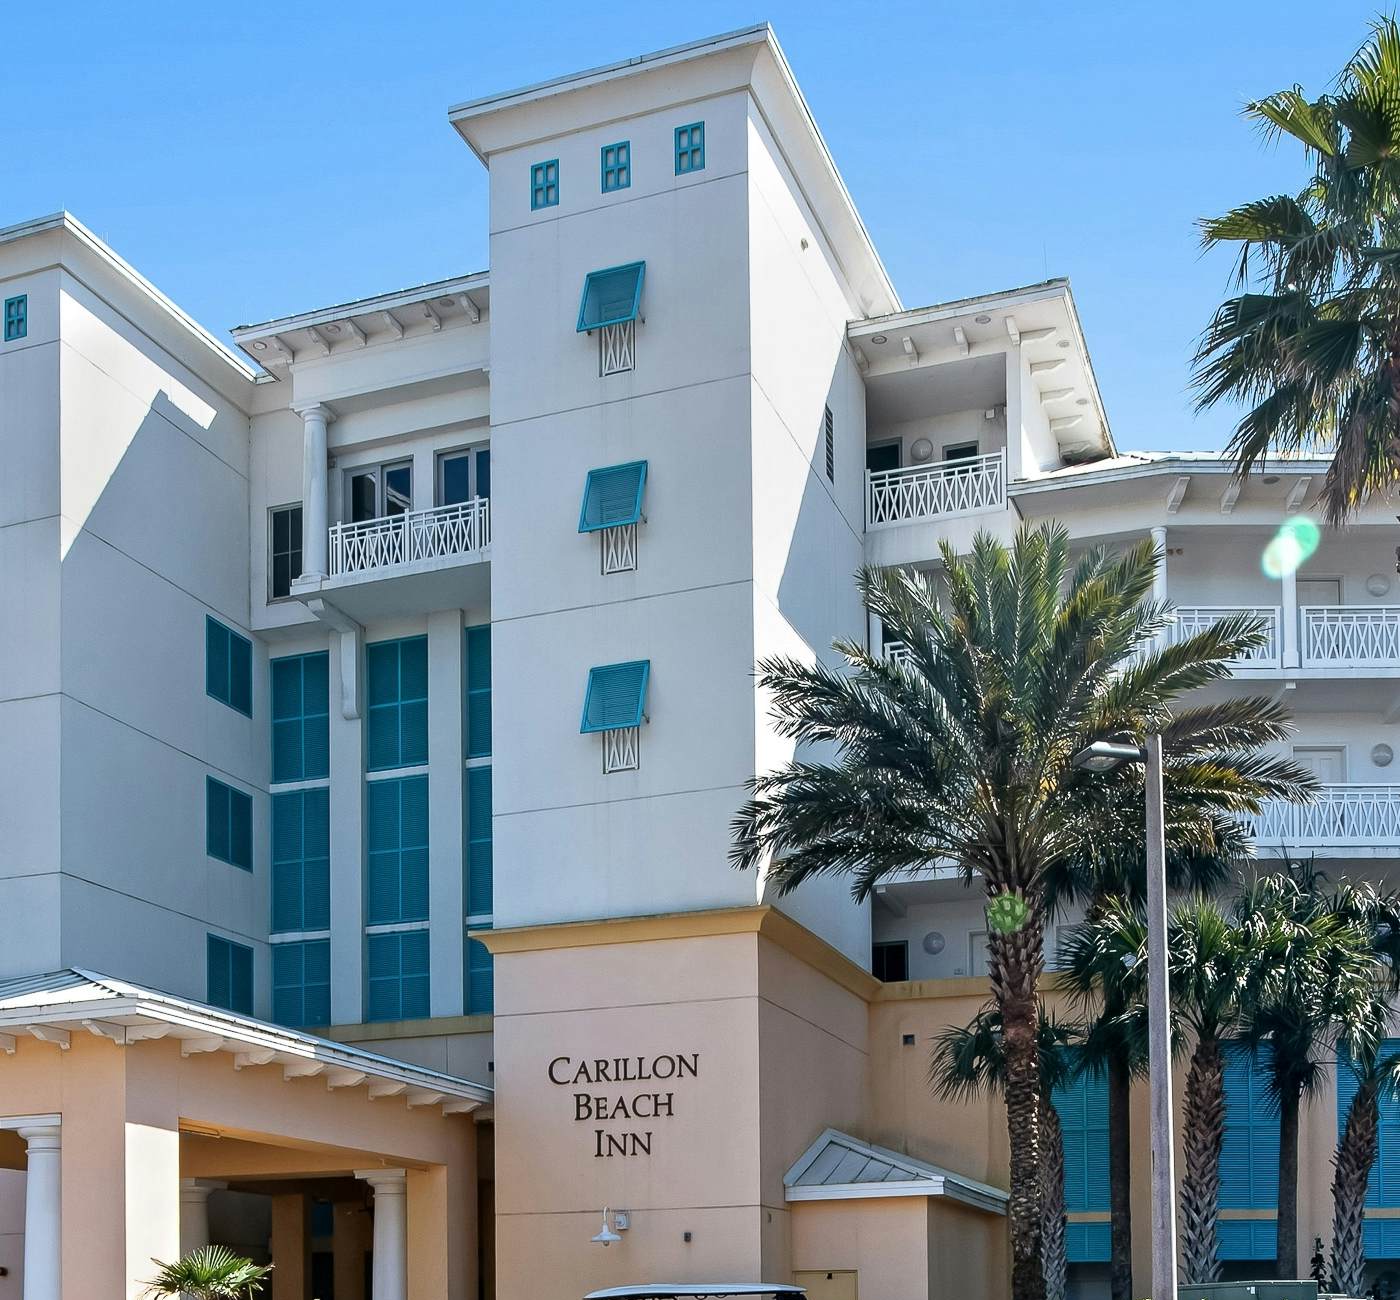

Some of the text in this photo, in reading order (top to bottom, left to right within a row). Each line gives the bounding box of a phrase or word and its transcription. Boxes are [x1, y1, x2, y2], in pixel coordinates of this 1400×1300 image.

[548, 1053, 699, 1086] CARILLON
[573, 1092, 674, 1121] BEACH
[594, 1129, 653, 1158] INN
